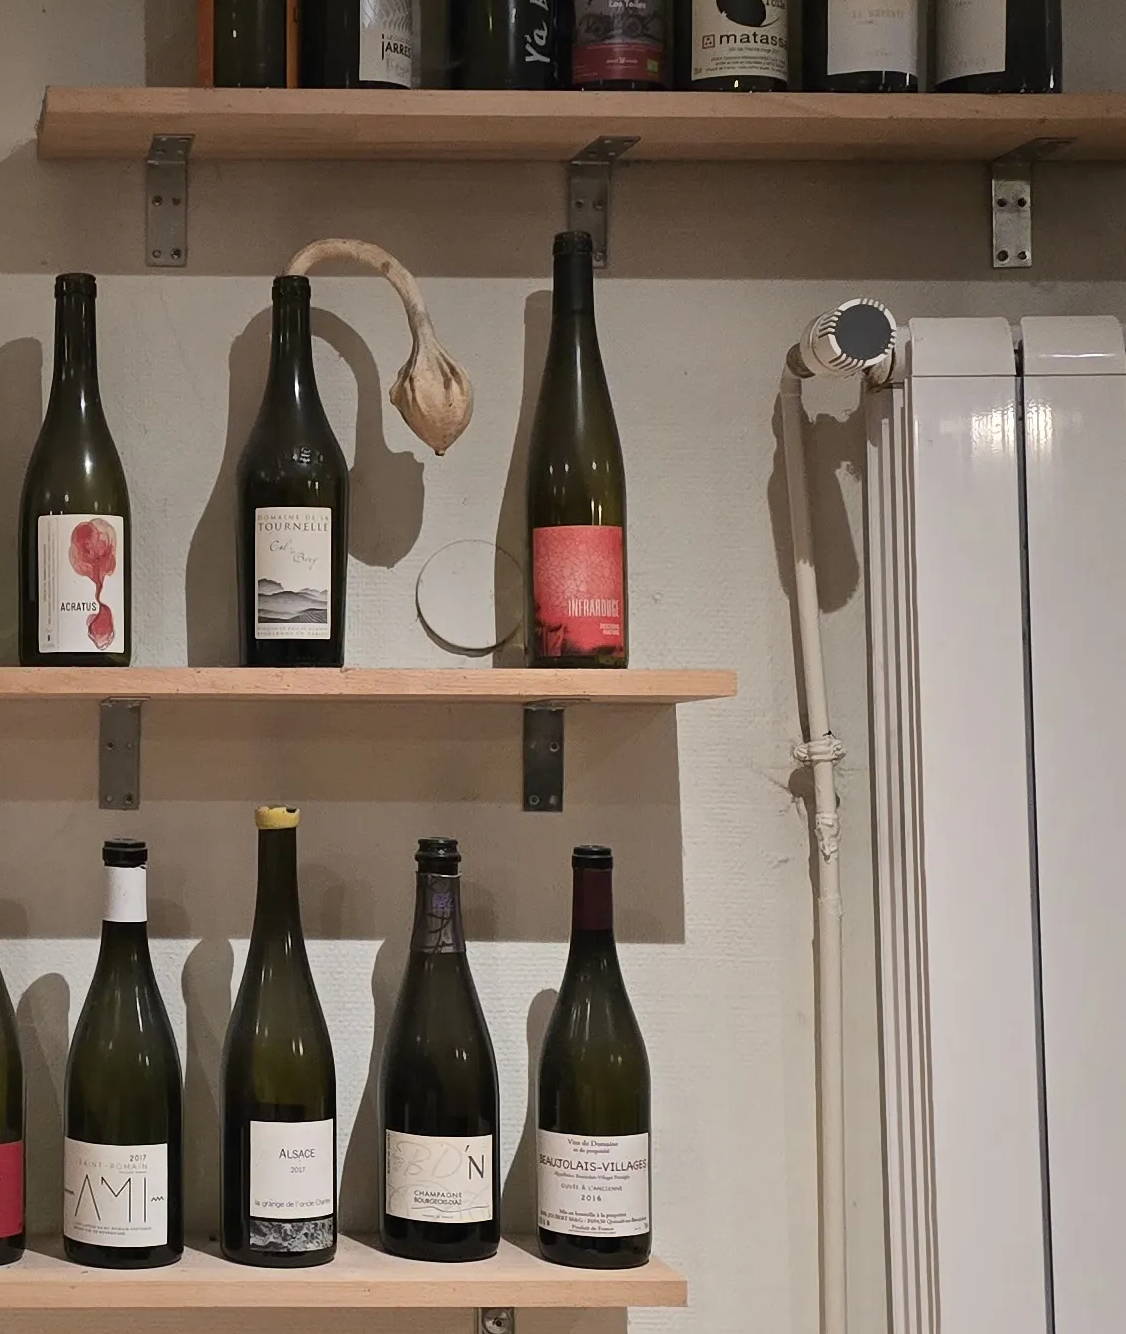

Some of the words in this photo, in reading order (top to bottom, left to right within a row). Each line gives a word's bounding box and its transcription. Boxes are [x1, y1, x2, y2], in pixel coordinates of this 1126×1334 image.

[719, 31, 787, 47] matass
[258, 522, 329, 532] TOURNELLE
[60, 602, 97, 612] ACRATUS
[129, 1154, 147, 1162] 2017
[278, 1148, 316, 1159] ALSACE
[539, 1153, 647, 1172] BEAUJOLAIS-VILLAGES
[290, 1166, 306, 1174] 2017
[414, 1189, 462, 1198] CHAMPAGNE
[581, 1194, 602, 1202] 2016
